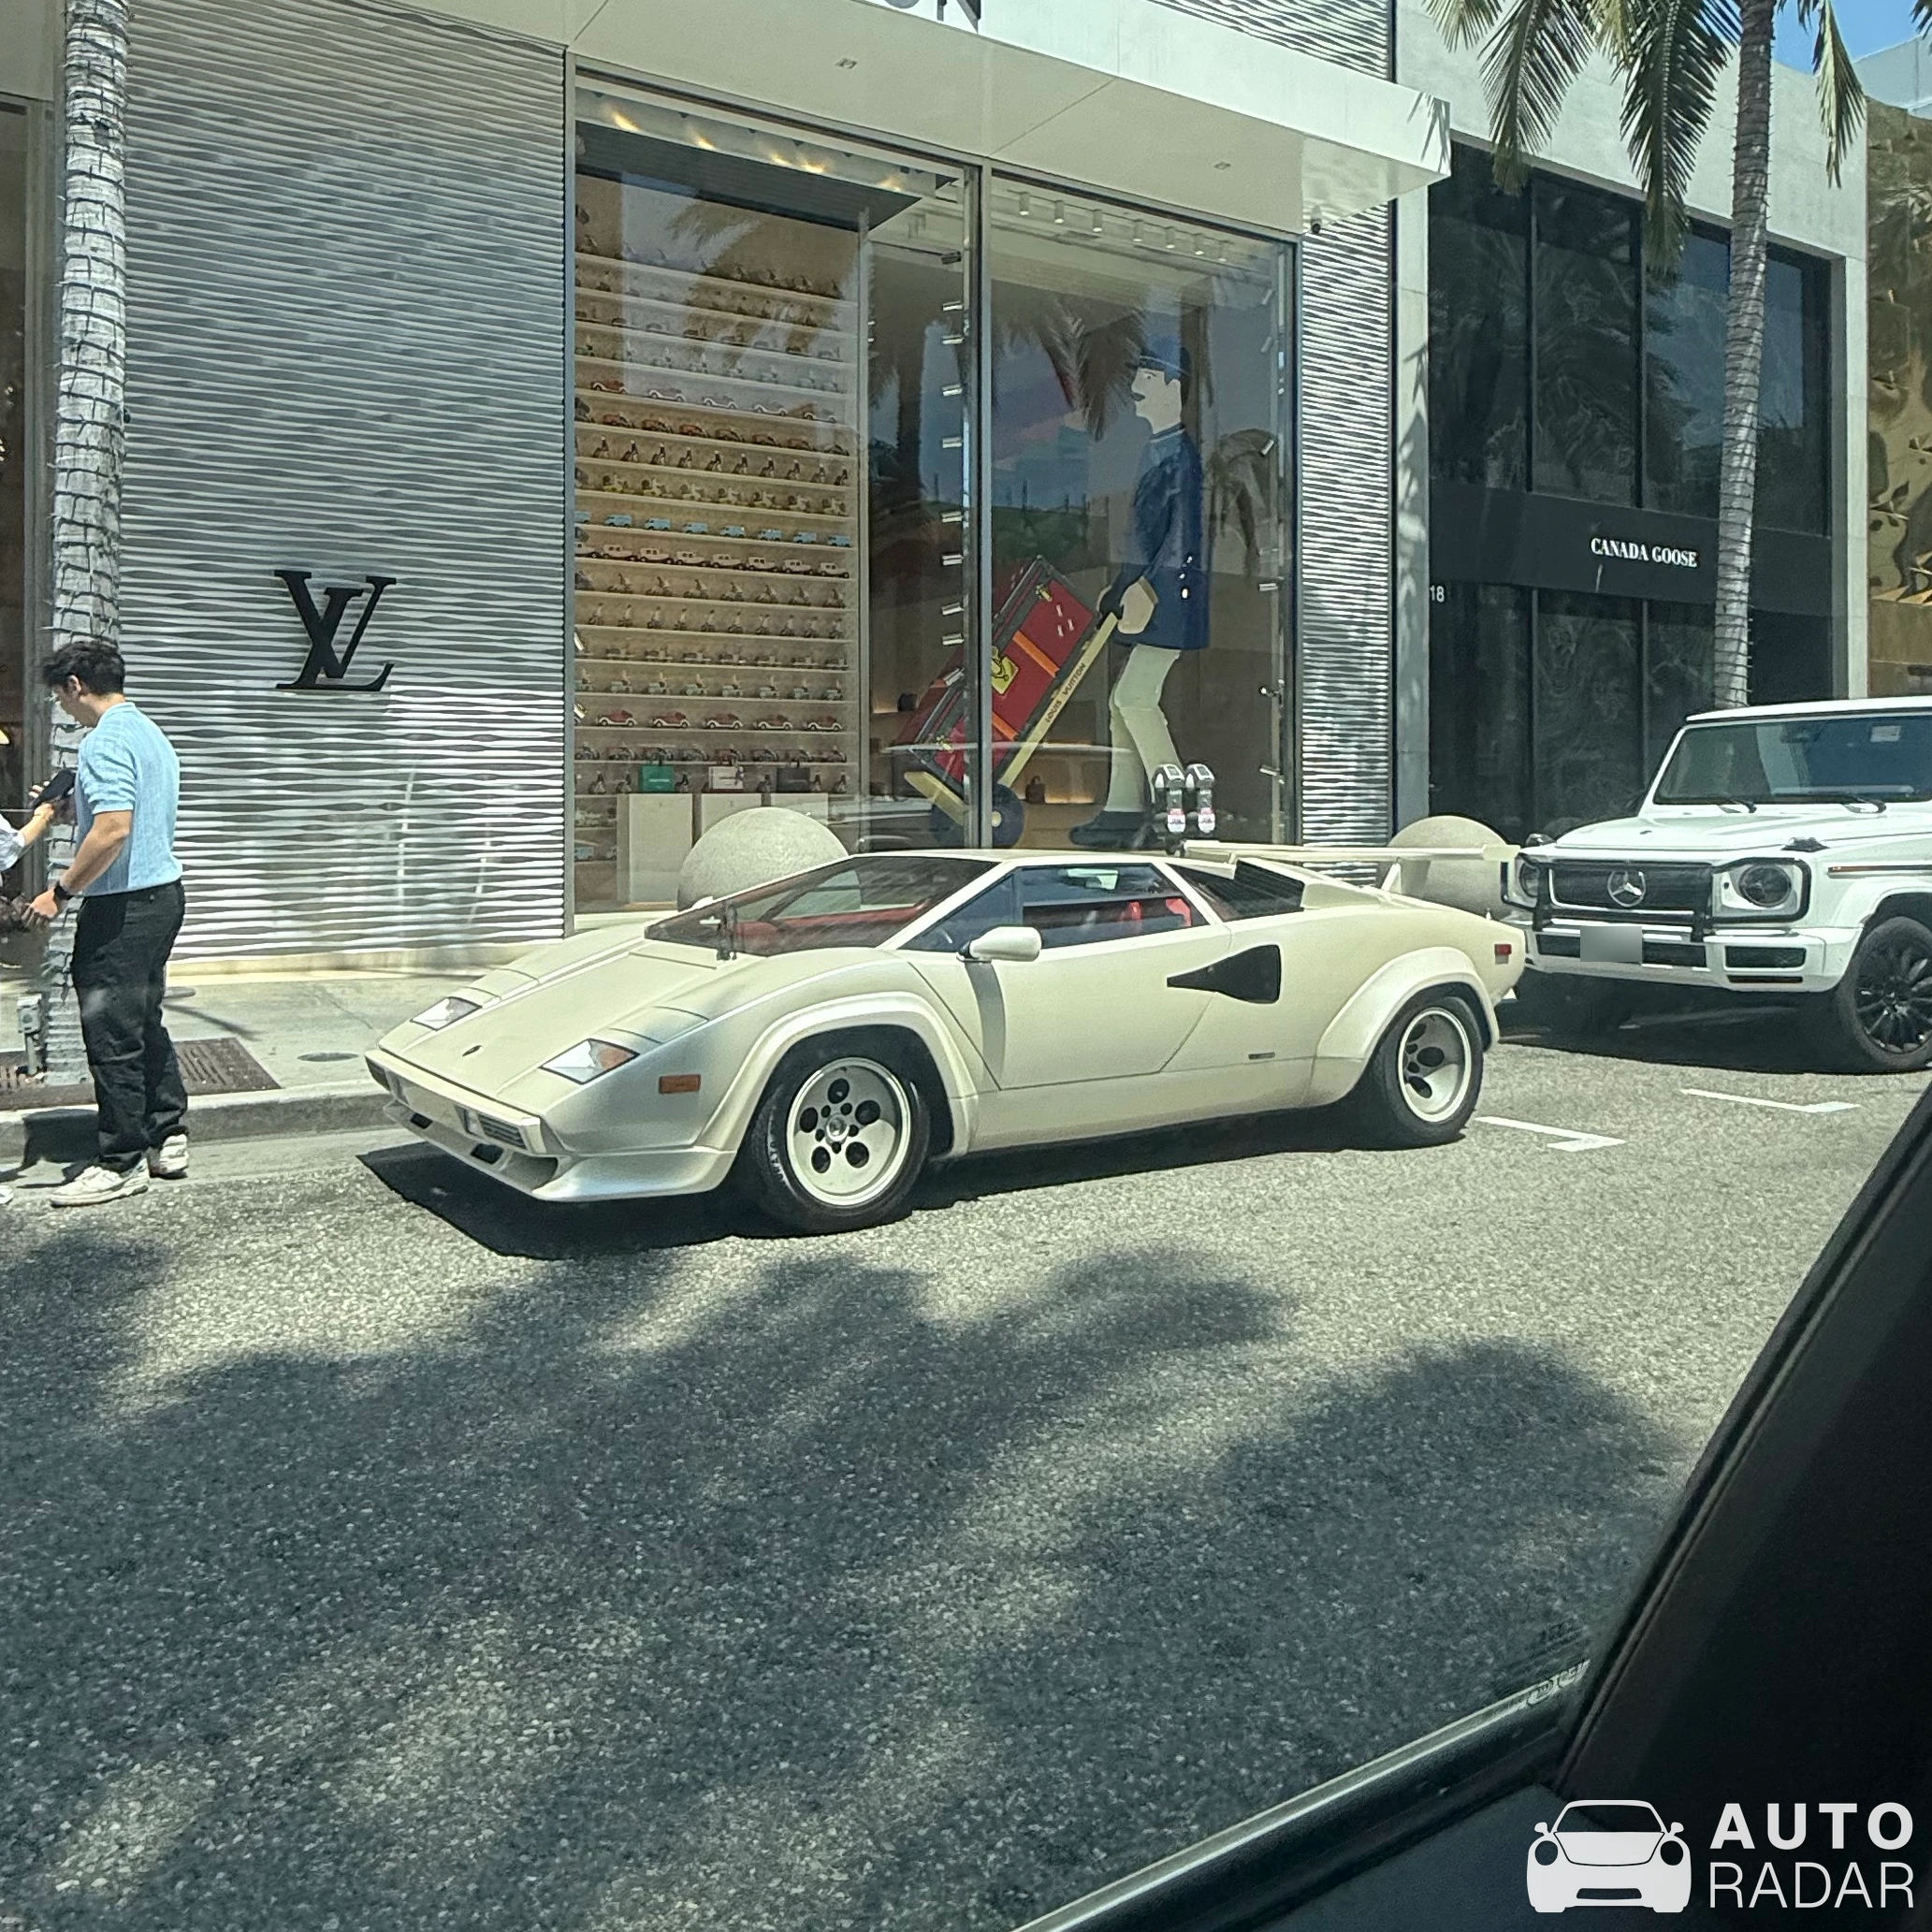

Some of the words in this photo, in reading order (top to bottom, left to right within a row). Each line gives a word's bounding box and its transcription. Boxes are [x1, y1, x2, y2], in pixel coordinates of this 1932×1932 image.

[1591, 538, 1649, 561] CANADA
[1651, 545, 1698, 568] GOOSE
[1045, 700, 1063, 723] LOUIS
[1062, 662, 1086, 695] VUITTON
